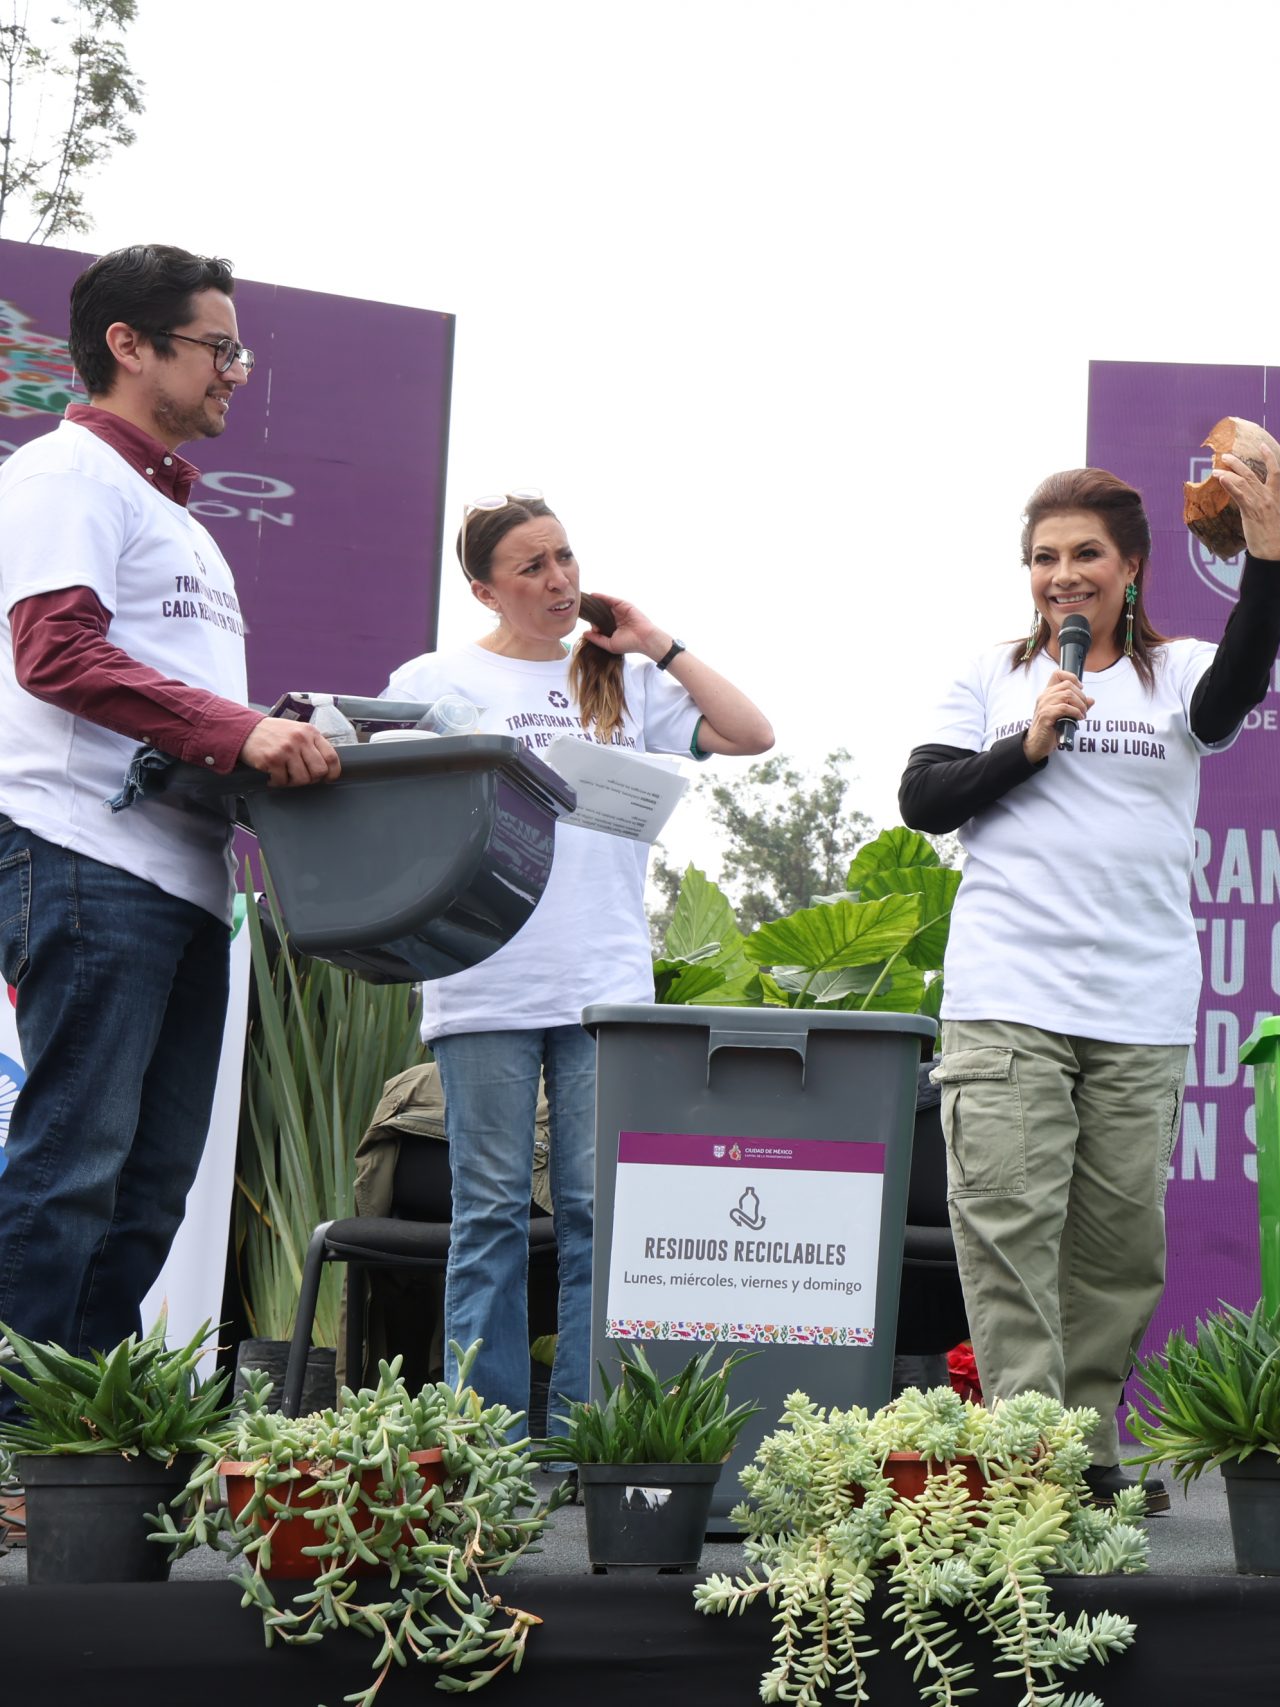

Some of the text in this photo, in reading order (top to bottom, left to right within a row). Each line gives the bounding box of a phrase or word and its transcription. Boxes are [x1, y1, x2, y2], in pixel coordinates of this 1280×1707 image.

[162, 600, 198, 618] CADA
[505, 713, 575, 730] TRANSFORMA
[1085, 719, 1101, 732] TU
[1106, 720, 1155, 735] CIUDAD
[1243, 708, 1278, 730] DE
[1080, 737, 1096, 752] EN
[1101, 738, 1119, 754] SU
[1124, 739, 1166, 760] LUGAR
[1167, 1102, 1218, 1182] N
[644, 1237, 846, 1266] RESIDUOS RECICLABLES
[623, 1271, 862, 1295] Lunes, miércoles, viernes y domingo
